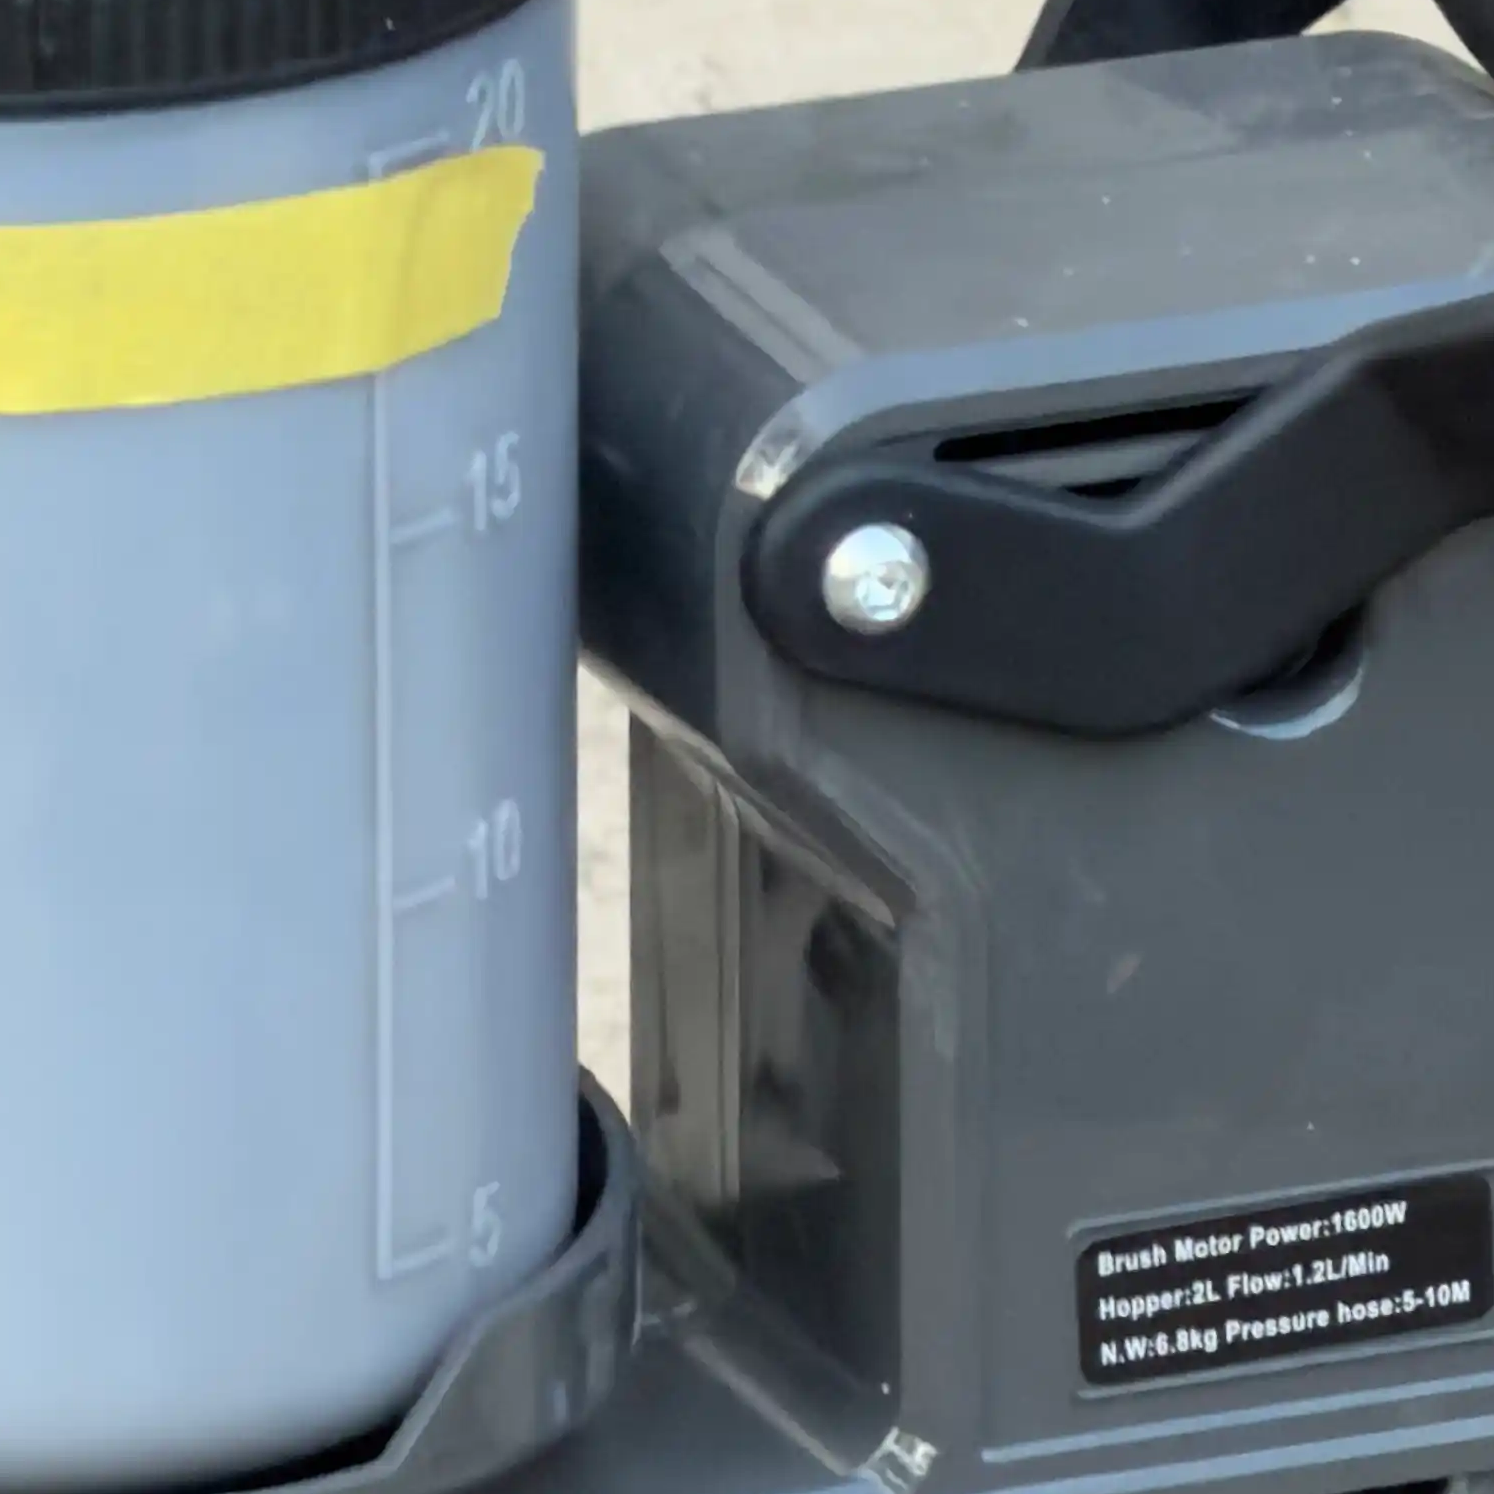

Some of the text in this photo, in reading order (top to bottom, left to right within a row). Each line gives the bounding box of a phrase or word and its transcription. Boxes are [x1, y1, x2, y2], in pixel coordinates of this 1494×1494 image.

[469, 430, 521, 532] 15
[467, 798, 522, 901] 10
[468, 1180, 501, 1268] 5
[1098, 1200, 1408, 1277] Brush Motor Power:1600W
[1098, 1250, 1391, 1325] Hopper:2L Flow:1.2L/Min
[1100, 1279, 1471, 1367] N.W:6.8kg Pressure hose:5-10M
